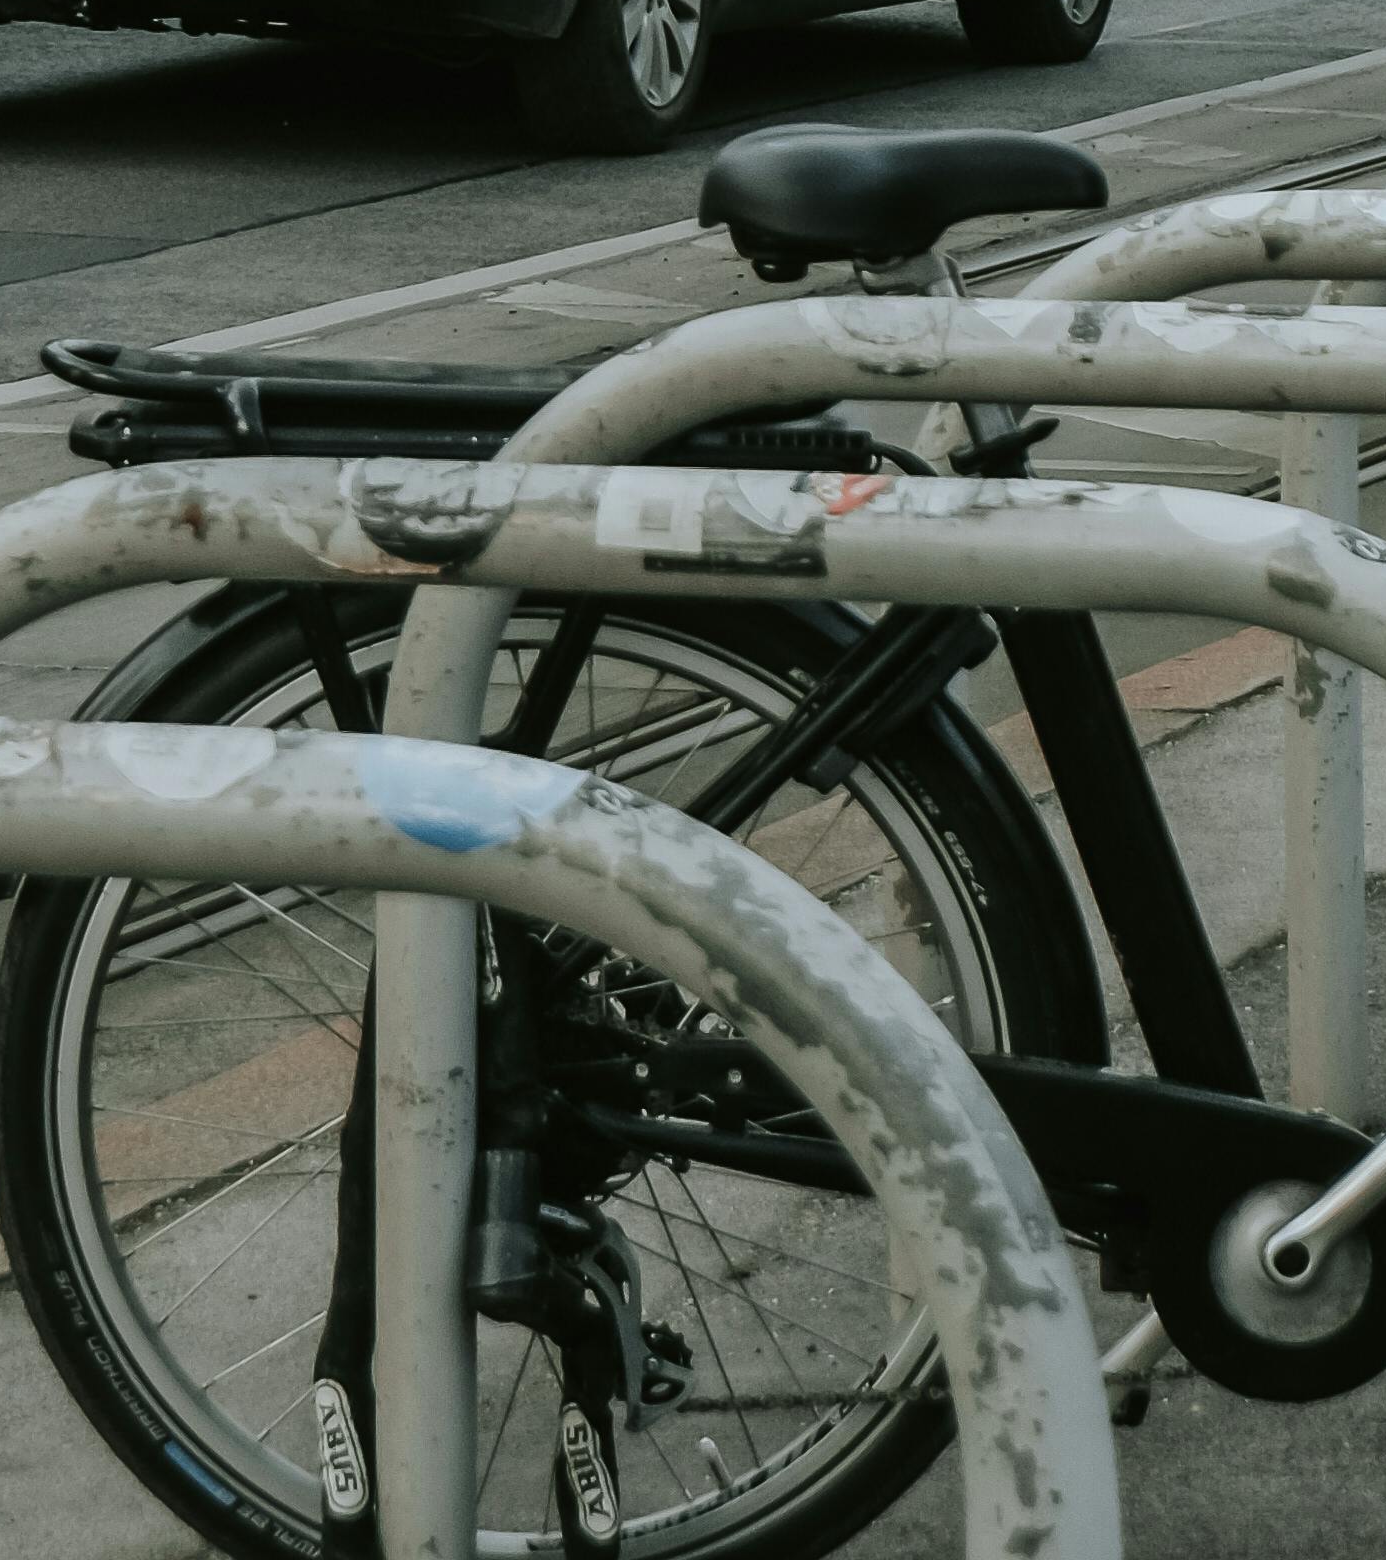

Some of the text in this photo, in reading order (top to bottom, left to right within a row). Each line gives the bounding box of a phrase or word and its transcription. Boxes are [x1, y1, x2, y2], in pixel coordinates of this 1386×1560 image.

[85, 1335, 167, 1441] MARATHON
[317, 1401, 359, 1494] ABUS
[565, 1421, 612, 1520] ABUS
